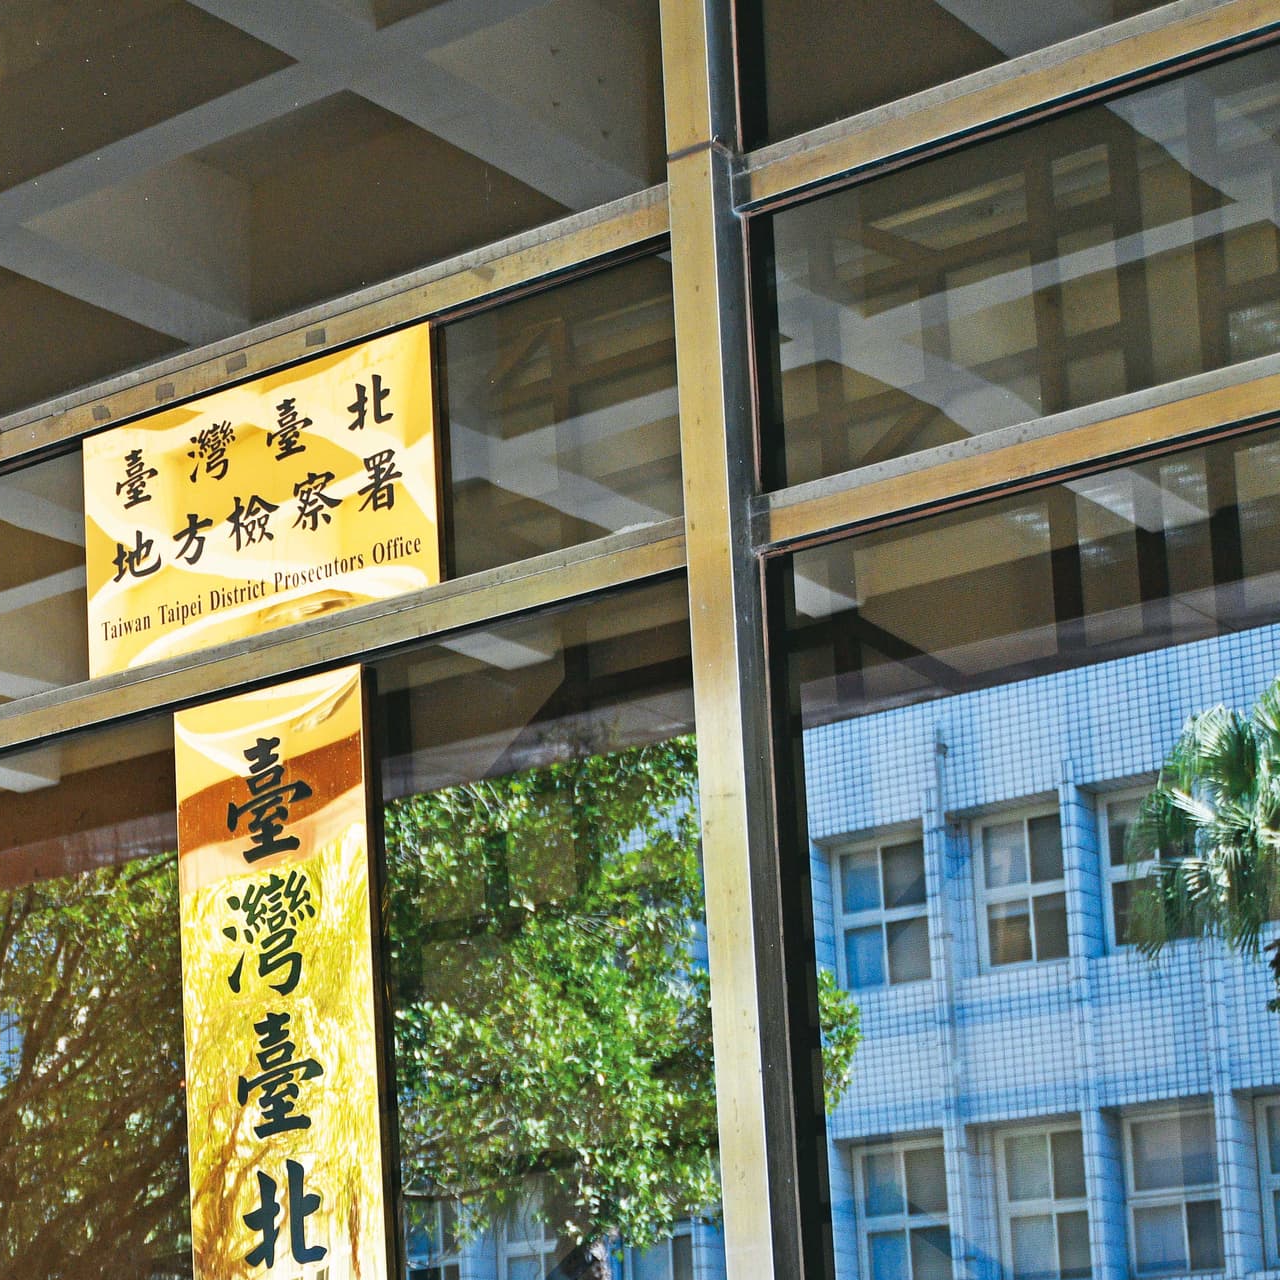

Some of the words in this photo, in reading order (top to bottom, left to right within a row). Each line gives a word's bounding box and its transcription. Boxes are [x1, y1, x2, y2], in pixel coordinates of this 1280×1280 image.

[115, 374, 394, 509] 臺灣臺北
[112, 448, 402, 584] 地方檢察署
[101, 614, 151, 641] Taiwan
[158, 594, 202, 625] Taipei
[210, 579, 266, 611] District
[274, 553, 365, 593] Prosecutors
[372, 536, 421, 564] Office
